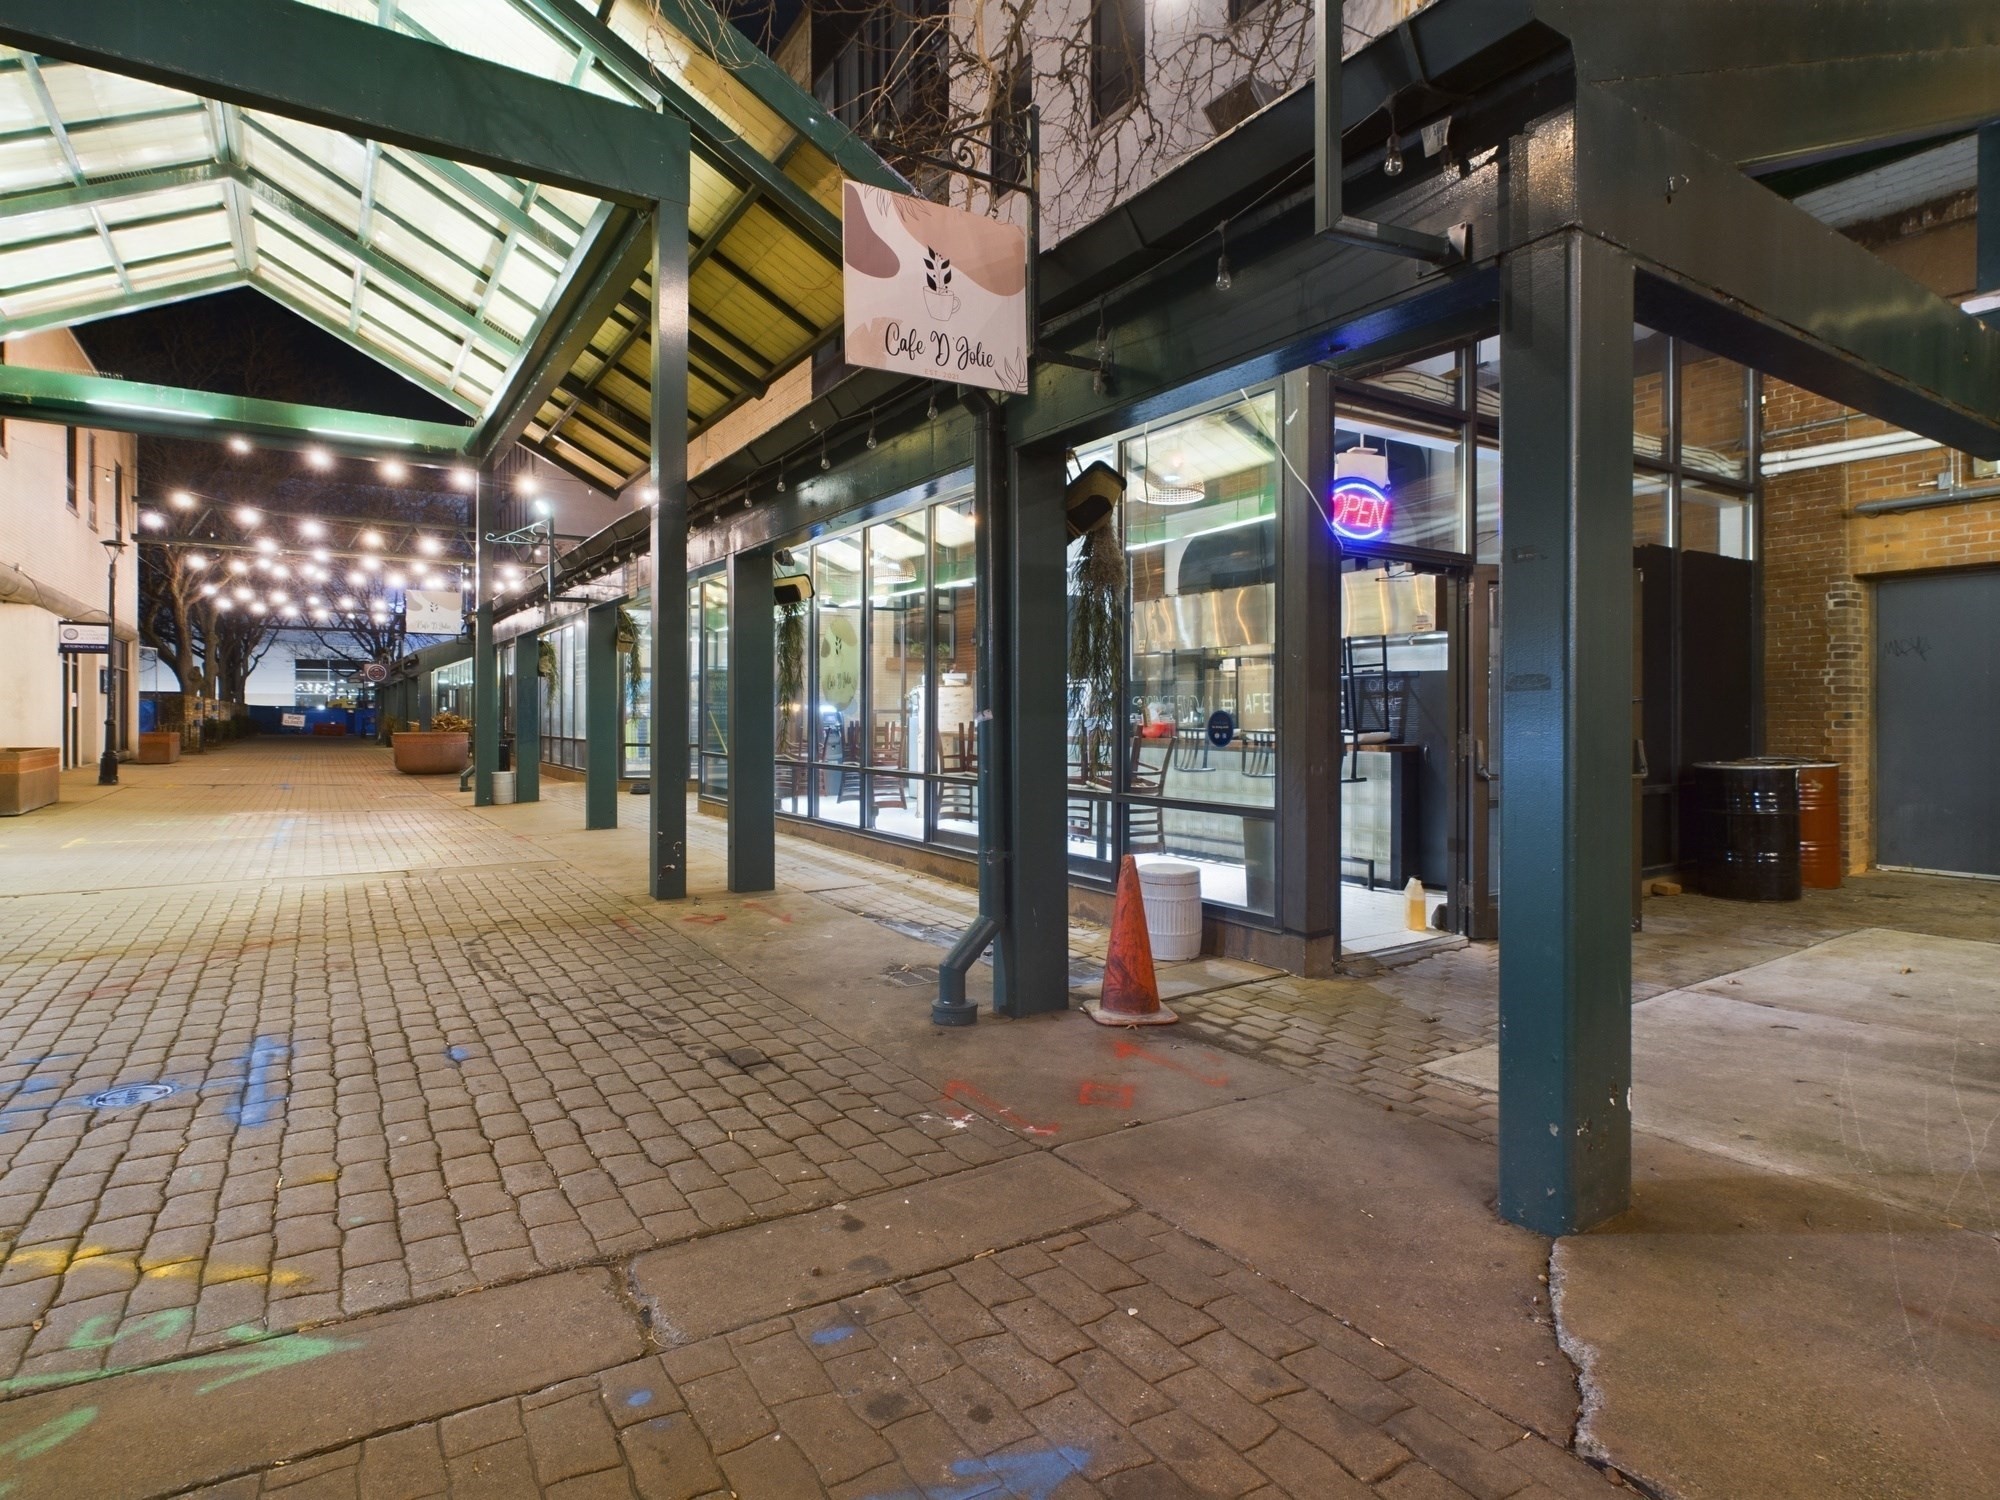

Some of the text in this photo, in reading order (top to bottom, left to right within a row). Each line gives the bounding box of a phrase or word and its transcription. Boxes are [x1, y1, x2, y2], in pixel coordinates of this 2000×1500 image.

[885, 322, 926, 361] Cafe
[943, 371, 960, 380] 2021
[1332, 493, 1389, 529] OPEN
